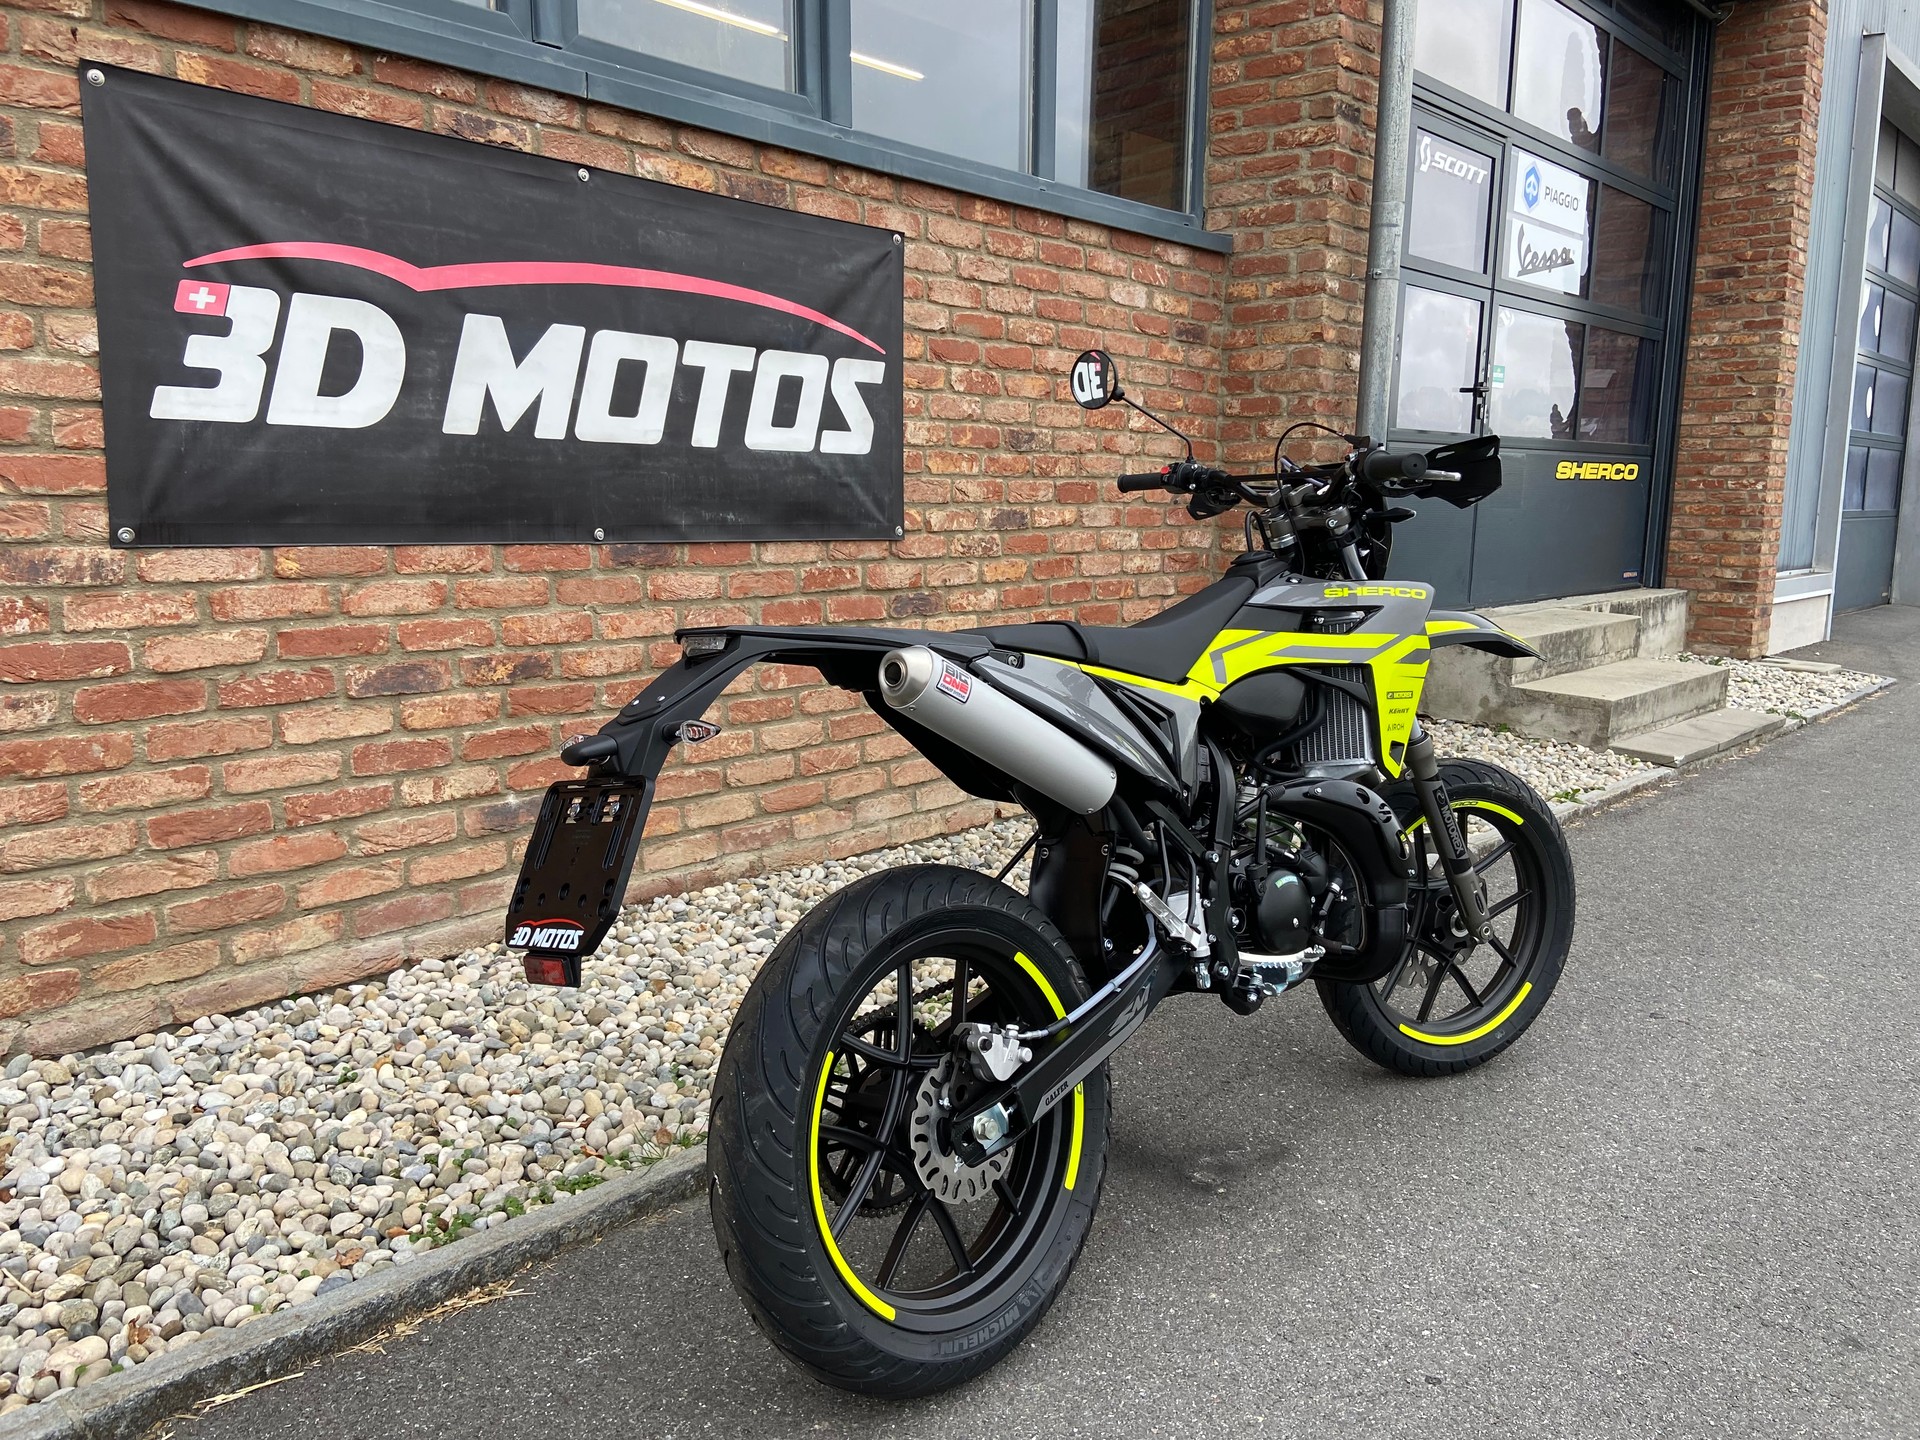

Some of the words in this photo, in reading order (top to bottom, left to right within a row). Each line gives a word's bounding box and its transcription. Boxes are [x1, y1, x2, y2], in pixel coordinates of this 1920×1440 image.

[1431, 152, 1488, 185] SCOTT
[1544, 185, 1579, 212] PIAGGIO
[1516, 223, 1575, 278] Vespa
[149, 280, 407, 429] 3D
[441, 312, 886, 455] MOTOS
[1555, 461, 1639, 481] SHERCO
[1323, 586, 1427, 600] SHERCO
[942, 673, 969, 695] ONE
[945, 663, 970, 686] BIG
[1441, 805, 1465, 855] MOTOREX
[508, 926, 532, 946] 3D
[528, 927, 585, 950] MOTOS
[1045, 1080, 1069, 1106] GALFER
[939, 1304, 1021, 1355] MICHELIN
